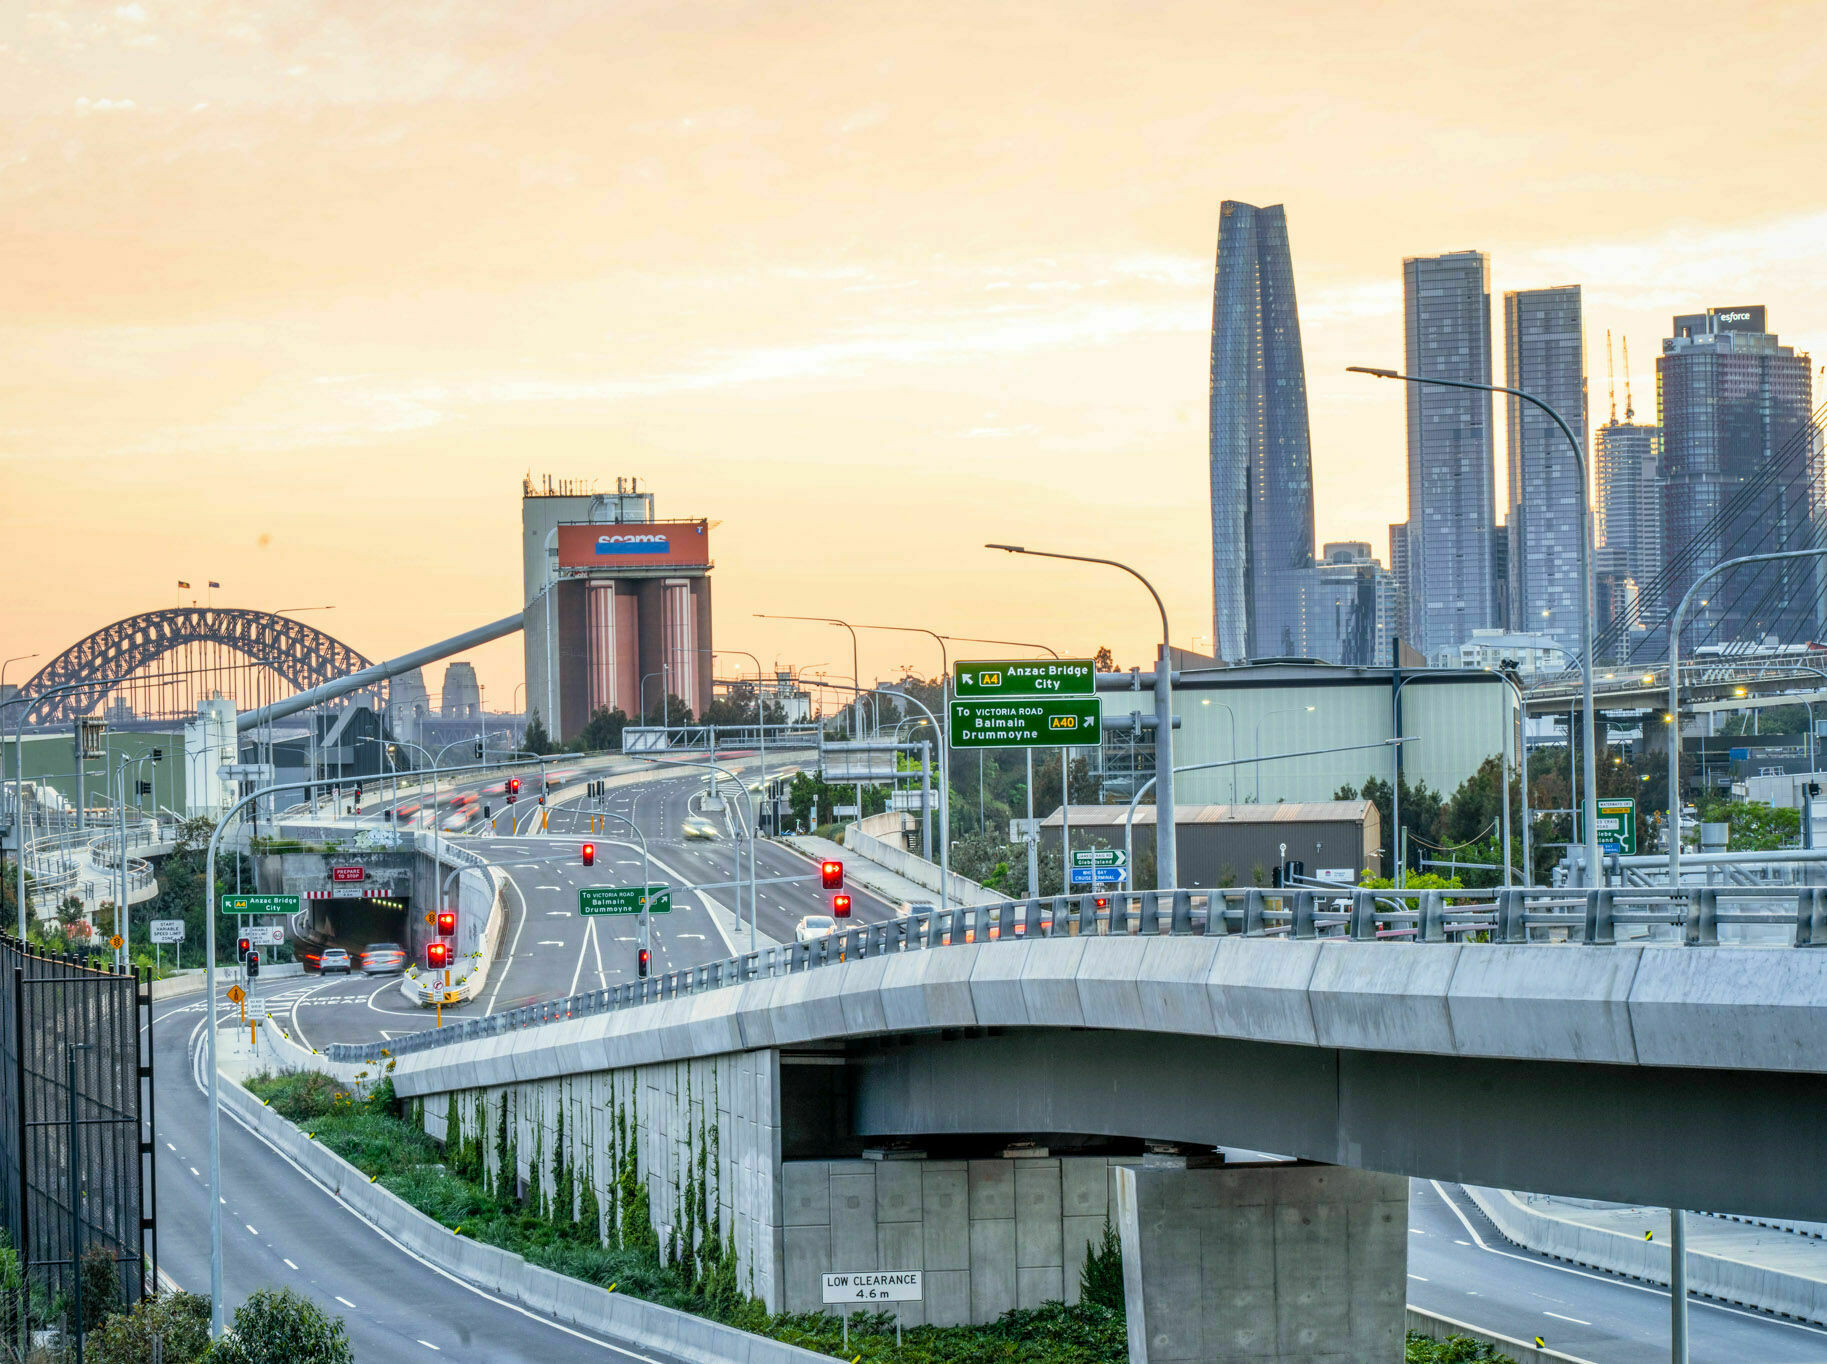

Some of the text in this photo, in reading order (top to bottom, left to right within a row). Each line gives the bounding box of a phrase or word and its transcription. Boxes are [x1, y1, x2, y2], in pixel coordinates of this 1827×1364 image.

[1719, 311, 1750, 323] esforce
[1007, 666, 1089, 677] Anzac Bridge
[983, 674, 999, 684] A4
[1035, 679, 1061, 690] City
[956, 707, 970, 716] To
[976, 708, 1017, 716] VICTORIA
[975, 718, 1025, 728] Balmain
[1052, 718, 1074, 728] A40
[962, 730, 1038, 741] Drummoyne
[585, 906, 633, 914] Drummoyne
[827, 1274, 917, 1287] LOW CLEARANCE
[855, 1289, 889, 1299] 4.6 m
